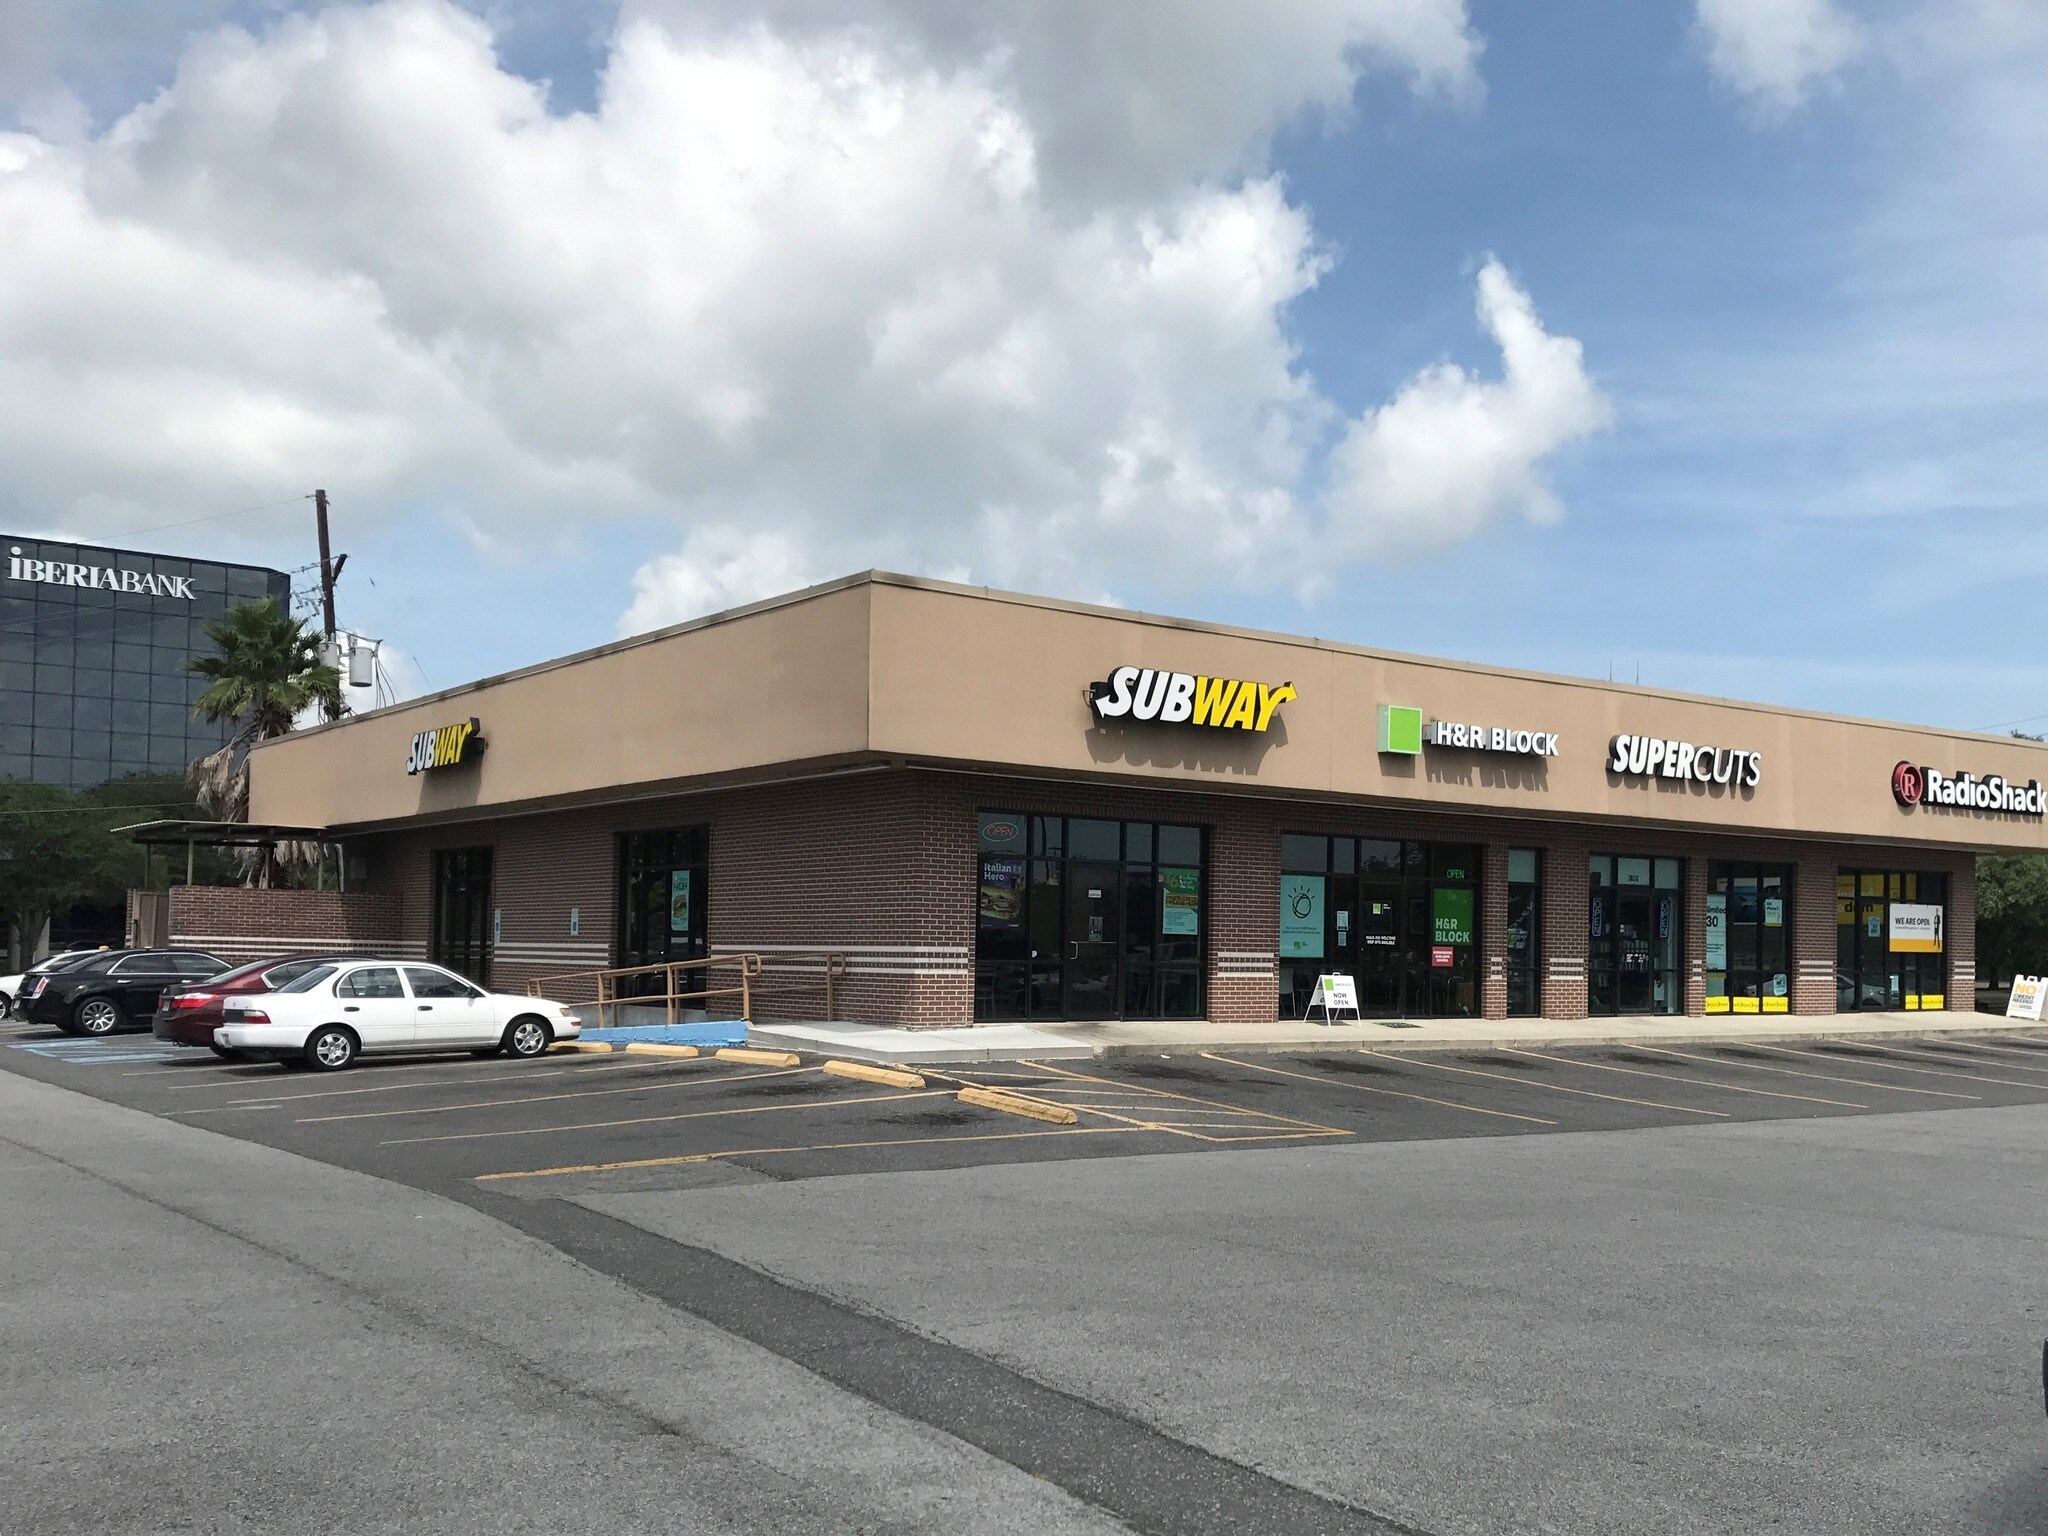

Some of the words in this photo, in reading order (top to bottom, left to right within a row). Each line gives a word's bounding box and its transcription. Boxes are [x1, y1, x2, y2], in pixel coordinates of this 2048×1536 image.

[1095, 666, 1298, 732] SUBWAY
[1437, 721, 1484, 749] H&R
[1491, 727, 1559, 756] BLOCK
[406, 721, 473, 773] SUBWAY
[1612, 734, 1762, 787] SUPERCUTS
[1927, 768, 2048, 814] RadioShack
[984, 862, 1012, 873] Italian
[1446, 868, 1465, 879] OPEN
[984, 871, 1005, 881] Hero
[1435, 918, 1458, 930] H&R
[1895, 917, 1905, 925] WE
[1906, 917, 1916, 926] ARE
[1435, 931, 1470, 943] BLOCK
[2015, 983, 2037, 995] NO
